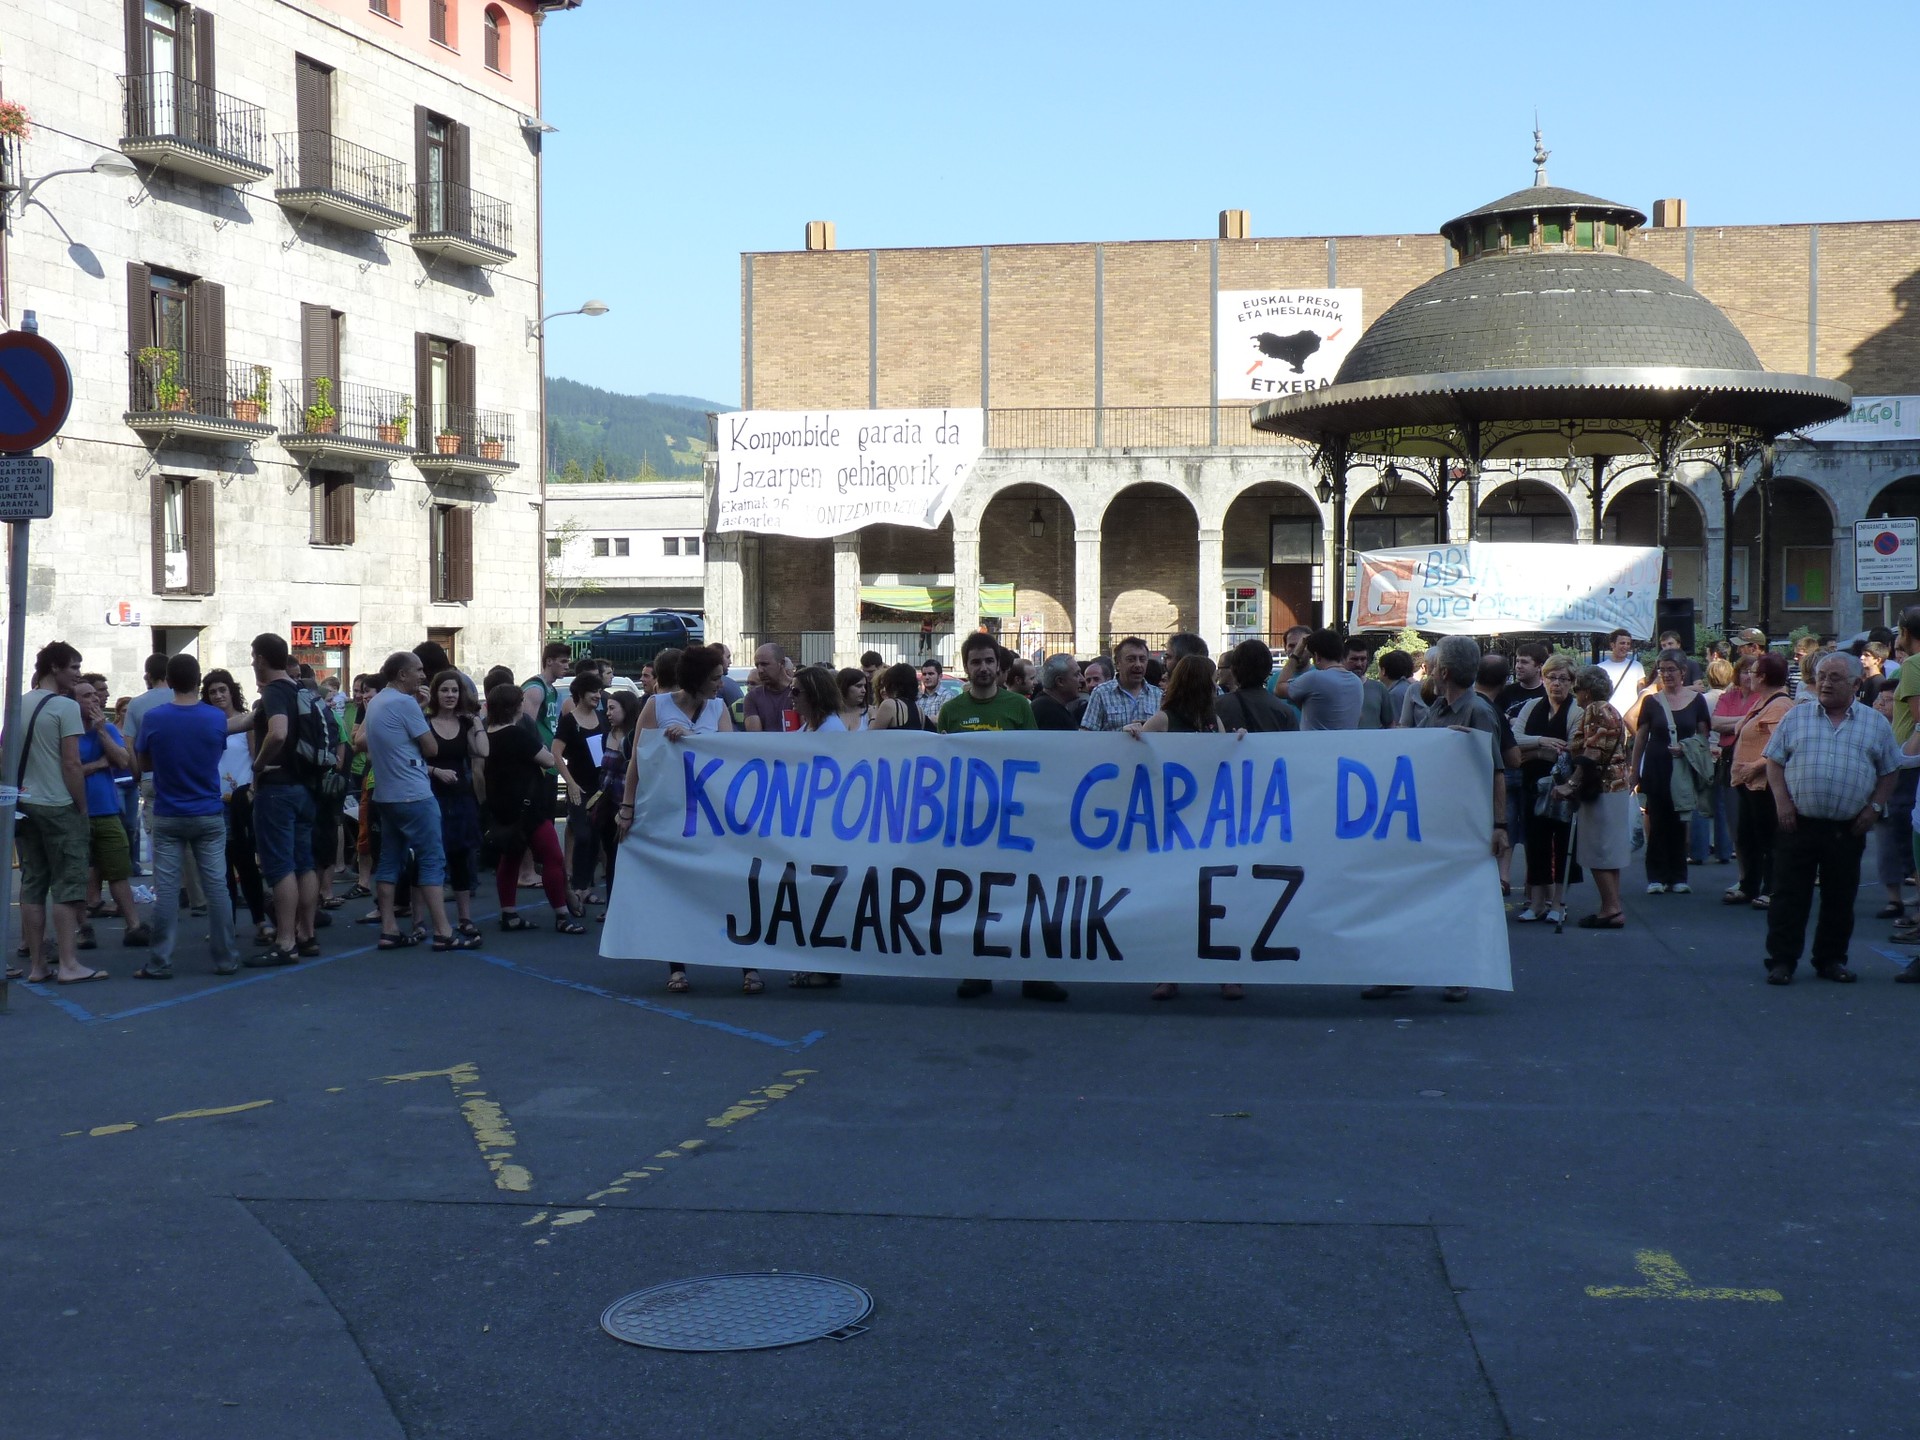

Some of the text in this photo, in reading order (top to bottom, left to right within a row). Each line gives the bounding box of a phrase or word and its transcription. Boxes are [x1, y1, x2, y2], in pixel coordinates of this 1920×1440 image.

[1237, 306, 1343, 323] ETA IHESLARIAK
[1242, 295, 1340, 310] EUSKAL PRESO
[729, 410, 960, 454] Konponbide garaia da
[729, 462, 822, 494] Jazarpen
[837, 454, 942, 494] gehiagorik
[0, 500, 39, 508] ARANTZA
[1415, 597, 1470, 625] gure
[682, 751, 1422, 853] KONPONBIDE GARAIA DA
[726, 857, 1304, 961] JAZARPENIK EZ
